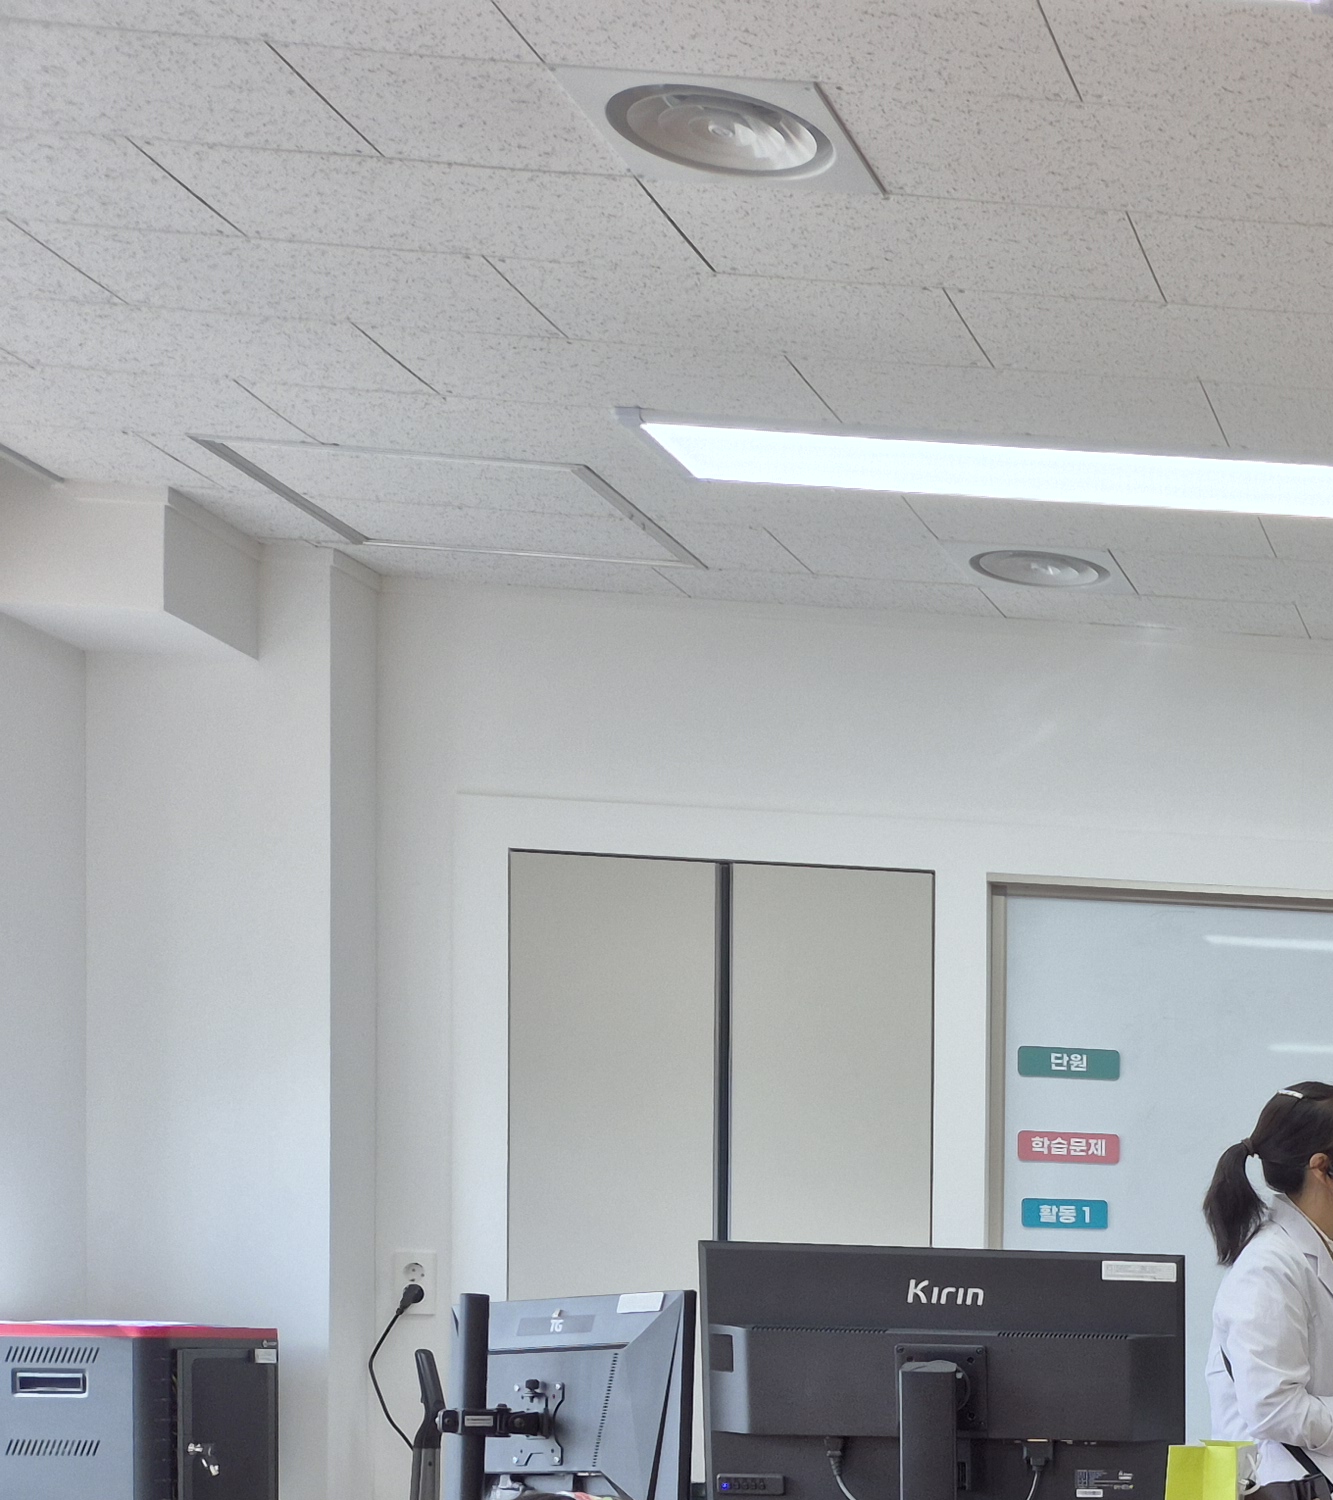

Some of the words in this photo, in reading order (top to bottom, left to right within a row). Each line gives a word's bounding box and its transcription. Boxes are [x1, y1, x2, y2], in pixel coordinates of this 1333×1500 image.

[1050, 1053, 1087, 1071] 단원
[1031, 1136, 1106, 1157] 학습문제
[1039, 1205, 1076, 1223] 활동
[1082, 1206, 1091, 1223] 1
[906, 1278, 985, 1307] Kirin
[550, 1319, 565, 1333] TG
